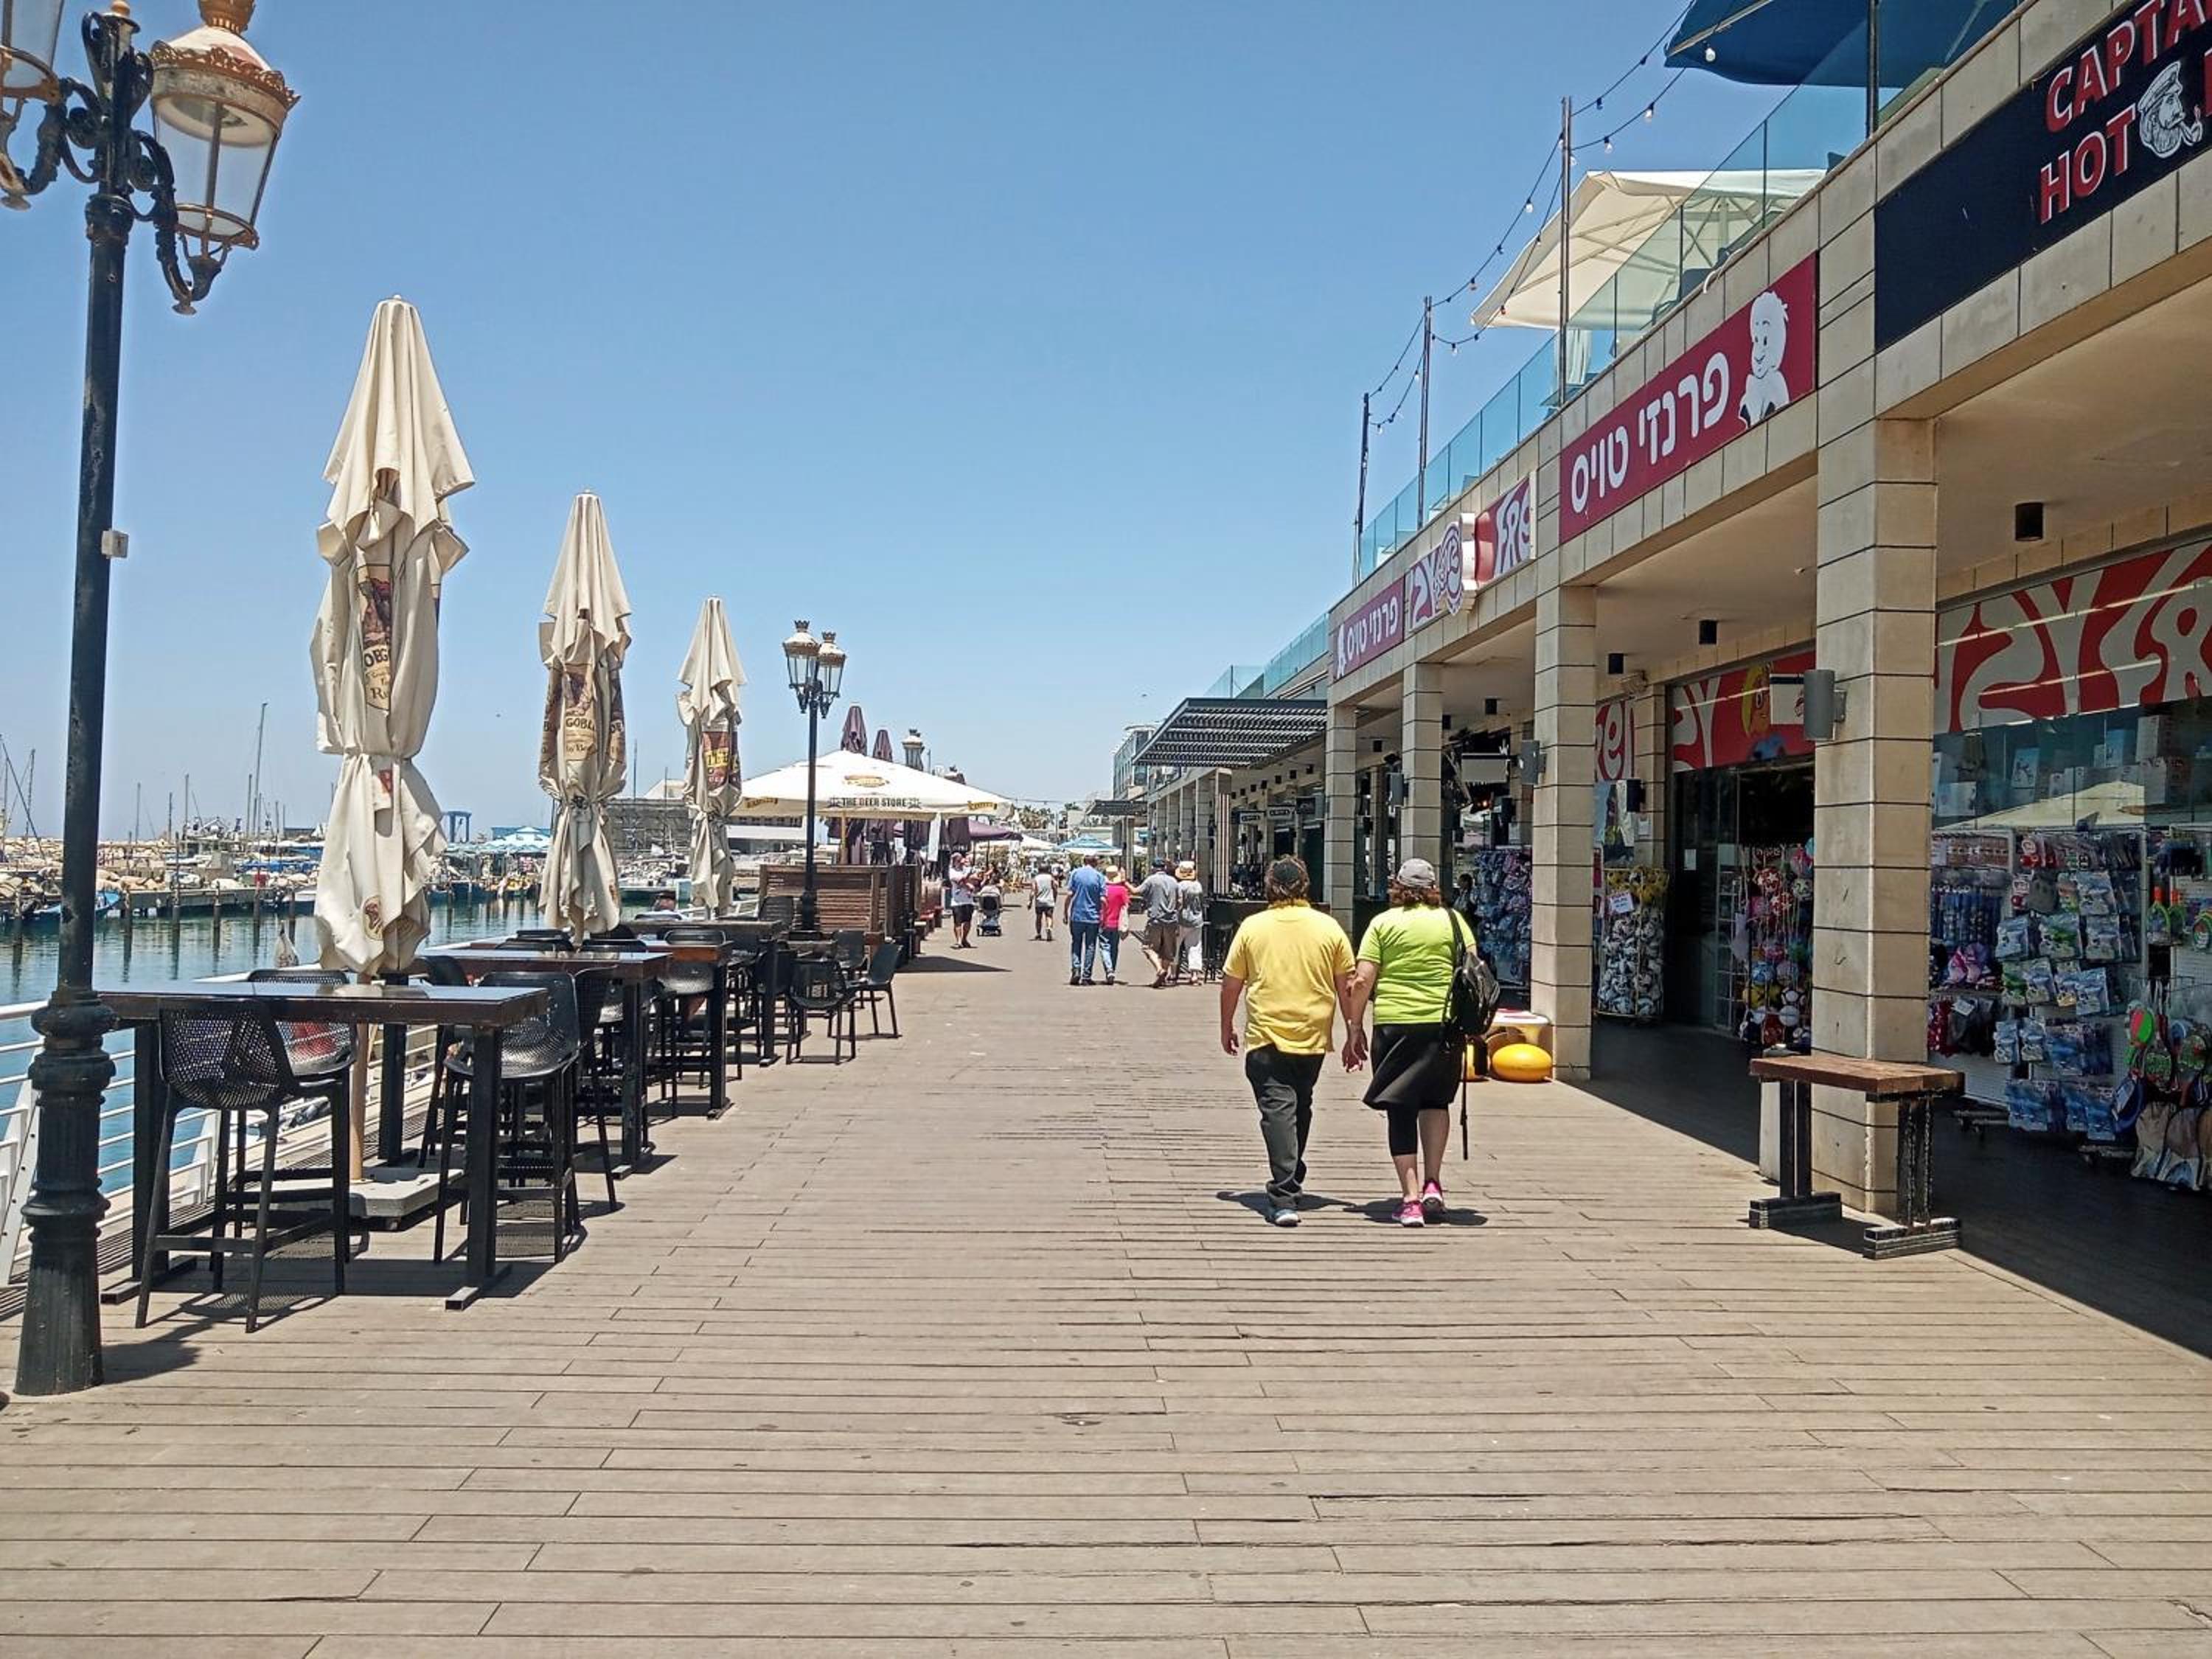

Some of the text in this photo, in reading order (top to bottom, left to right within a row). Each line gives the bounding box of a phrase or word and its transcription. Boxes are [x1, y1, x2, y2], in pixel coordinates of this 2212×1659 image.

[2045, 0, 2212, 133] CAPTA
[2039, 102, 2137, 224] HOT
[1571, 352, 1729, 514] פרנזי טויס
[1369, 596, 1398, 646] פרנזי
[882, 797, 906, 807] STORE
